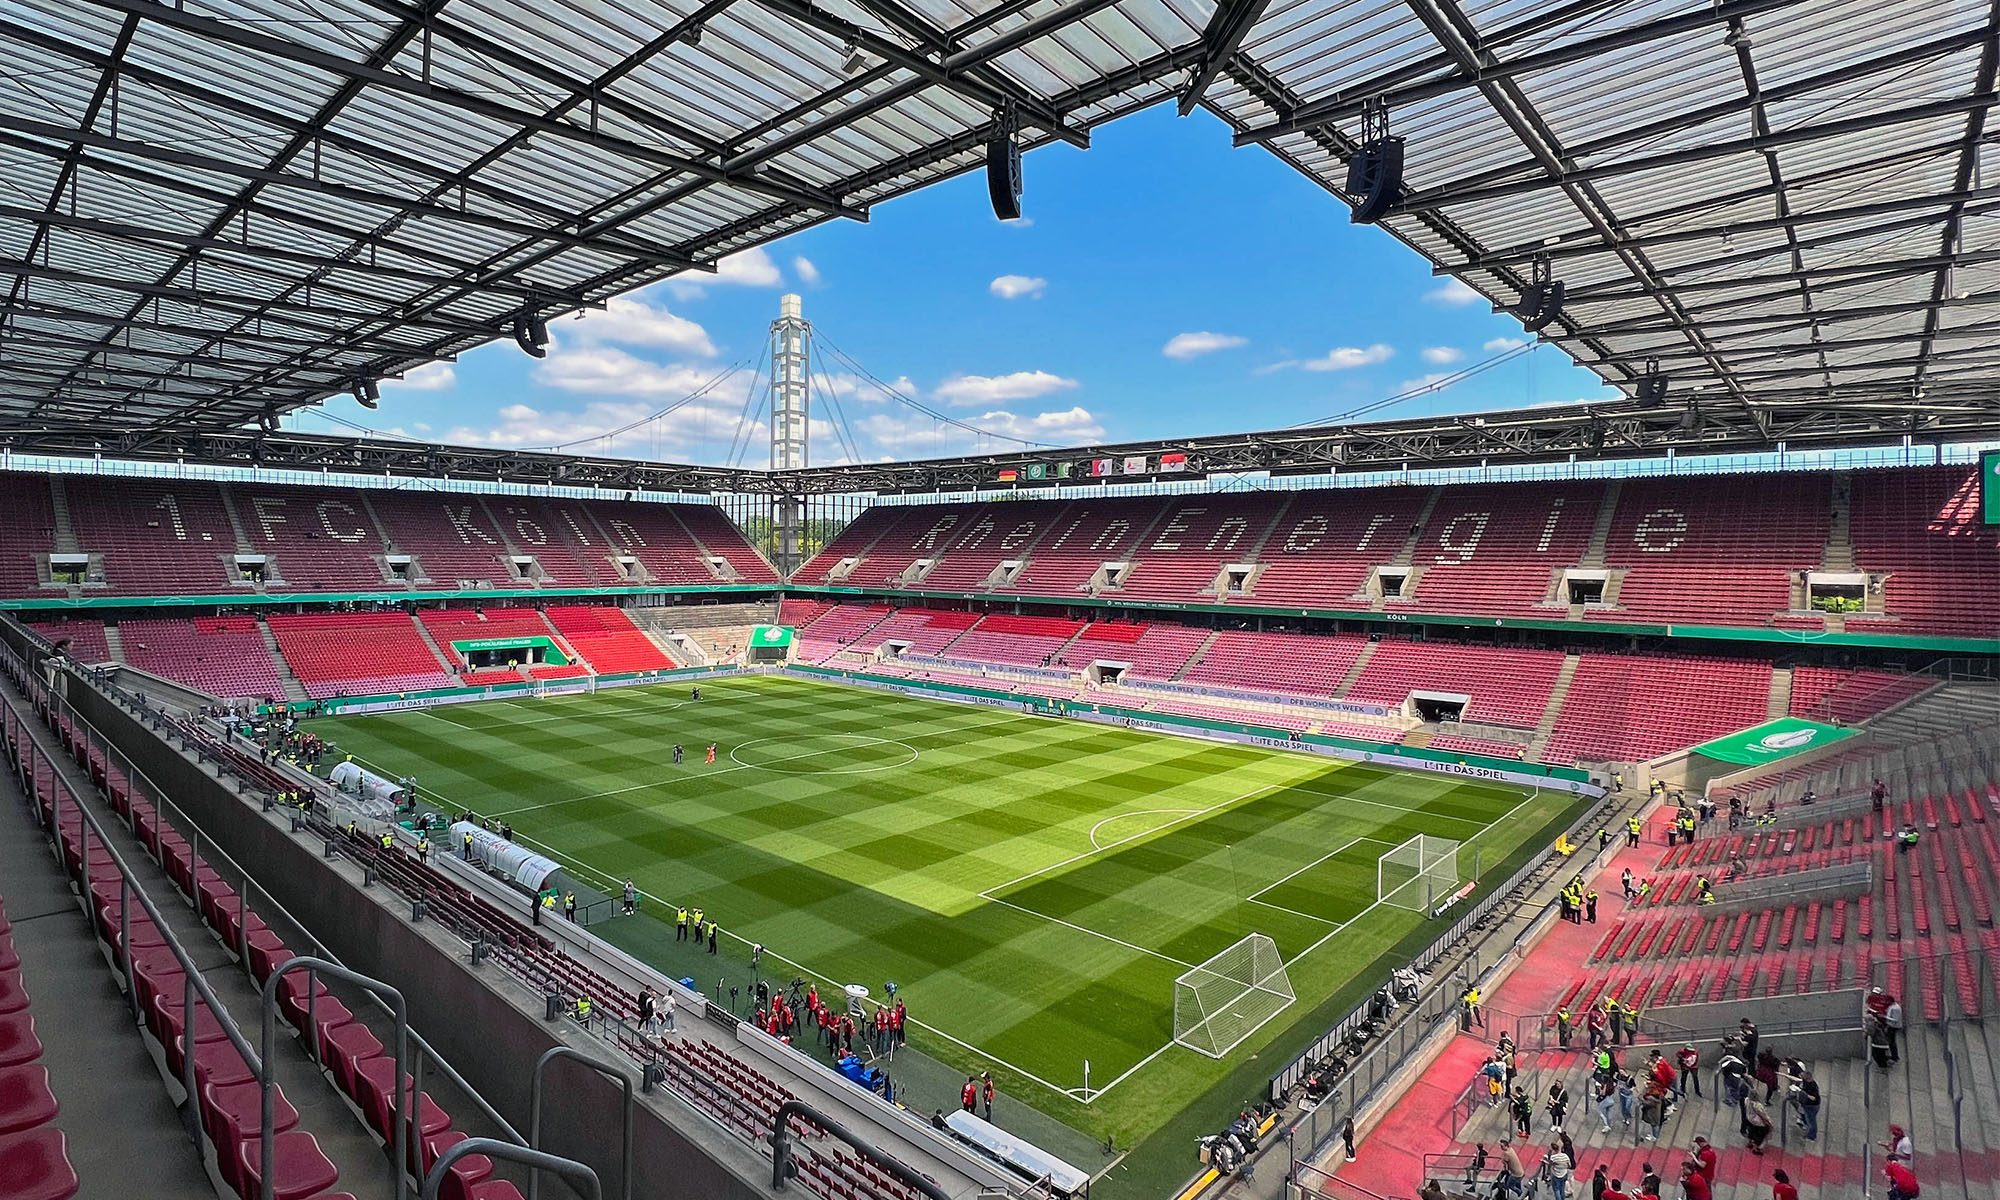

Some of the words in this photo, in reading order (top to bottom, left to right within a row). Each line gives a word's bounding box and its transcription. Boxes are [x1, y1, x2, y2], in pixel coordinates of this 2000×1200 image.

[252, 498, 367, 543] FC
[442, 504, 648, 547] Köln
[1148, 683, 1176, 691] WOMEN'S
[1177, 686, 1195, 694] WEEK
[407, 699, 422, 707] DAS
[1290, 698, 1304, 706] DFB
[1305, 700, 1341, 710] WOMEN'S
[1342, 704, 1365, 713] WEEK
[1130, 719, 1143, 727] DAS
[1273, 740, 1290, 748] DAS
[1454, 765, 1474, 775] DAS
